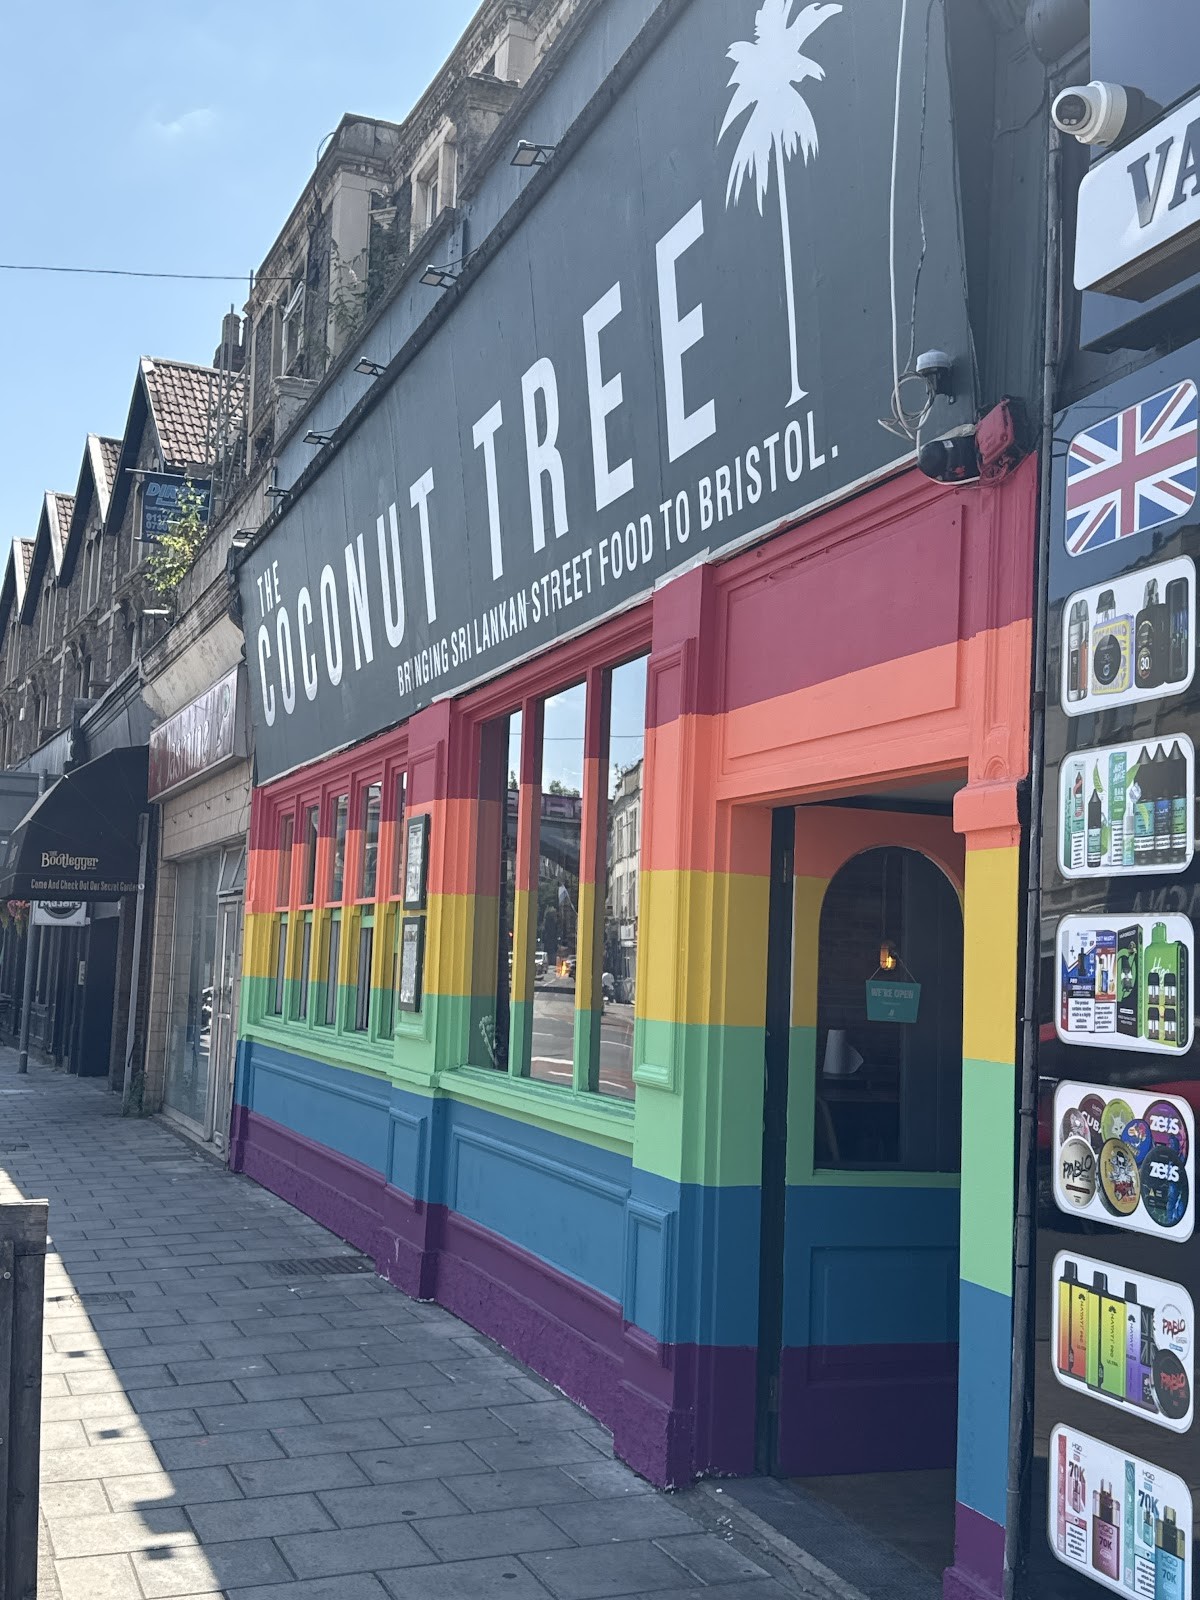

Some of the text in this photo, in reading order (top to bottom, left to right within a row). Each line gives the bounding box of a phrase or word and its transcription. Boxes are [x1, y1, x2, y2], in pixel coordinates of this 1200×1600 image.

[258, 199, 716, 727] COCONUT TREE
[451, 623, 472, 668] SRI
[474, 589, 528, 655] LANKAN
[531, 548, 592, 623] STREET
[599, 513, 653, 586] FOOD
[659, 490, 690, 551] TO
[699, 410, 839, 531] BRISTOL.
[257, 560, 282, 617] THE
[1140, 657, 1150, 670] 30
[41, 852, 98, 870] Bootlegger
[31, 879, 47, 889] Come
[48, 880, 59, 889] And
[60, 880, 78, 890] Check
[79, 881, 89, 890] Out
[100, 881, 119, 891] Secret
[1063, 1154, 1093, 1182] PABLO
[1162, 1318, 1186, 1339] PABLO
[1069, 1460, 1086, 1484] 70K
[1138, 1489, 1159, 1519] 70K
[1099, 1537, 1113, 1551] 70K
[1162, 1569, 1177, 1584] 70K
